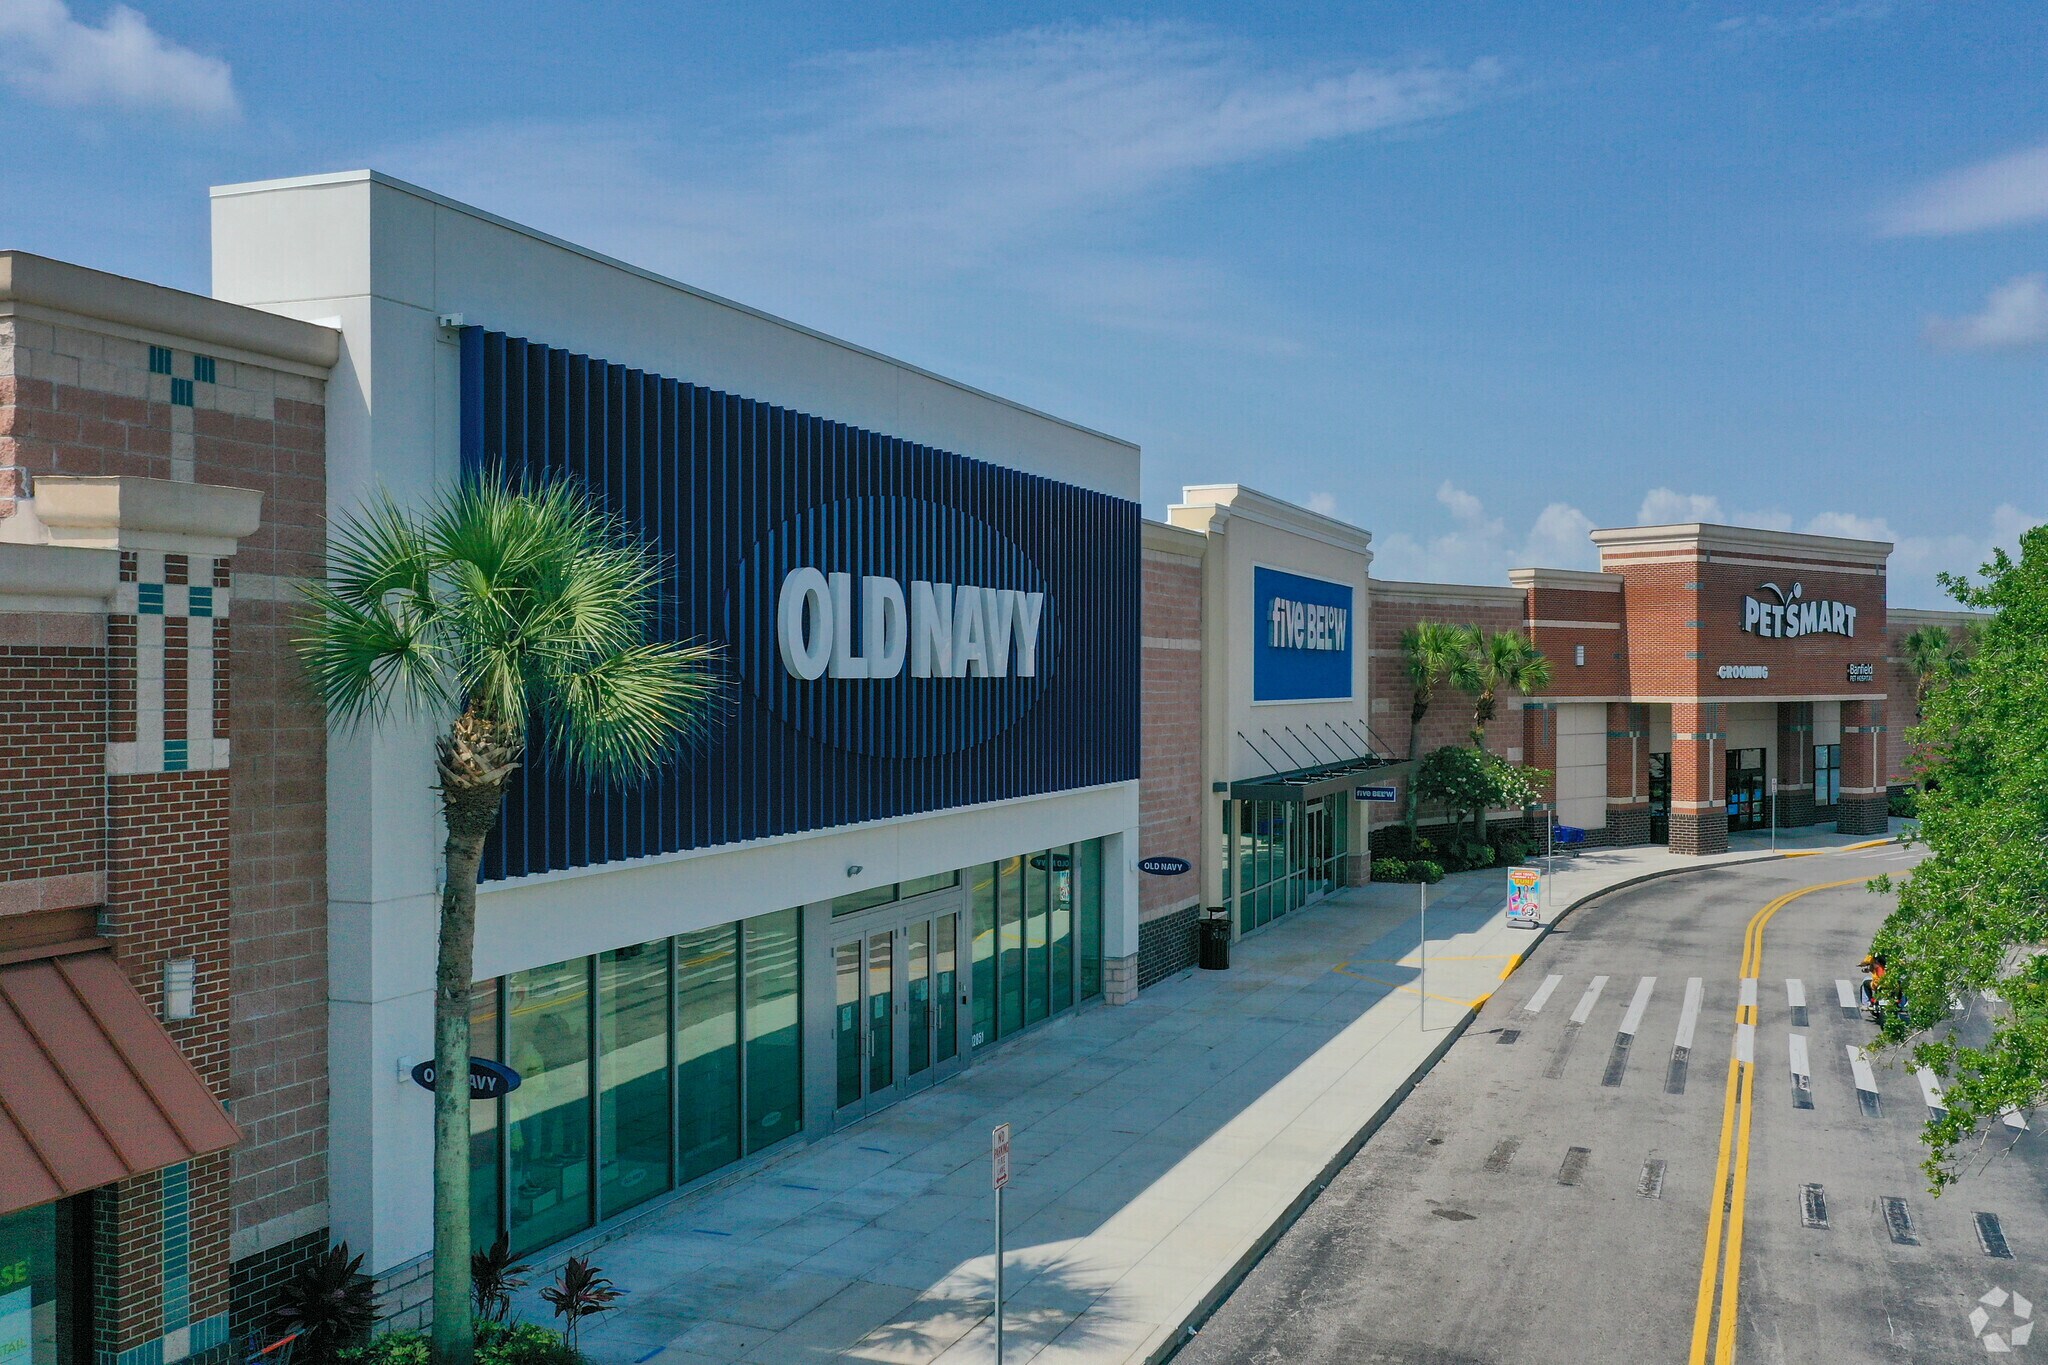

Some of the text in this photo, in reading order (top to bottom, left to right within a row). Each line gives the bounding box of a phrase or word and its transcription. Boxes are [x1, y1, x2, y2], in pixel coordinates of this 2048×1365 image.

[778, 567, 1043, 681] OLD NAVY
[1271, 597, 1304, 649] five
[1745, 596, 1856, 637] PETSMART
[1719, 665, 1768, 679] GROOMING
[1849, 664, 1873, 674] Banfield
[1144, 862, 1183, 871] OLD NAVY
[470, 1074, 497, 1092] AVY
